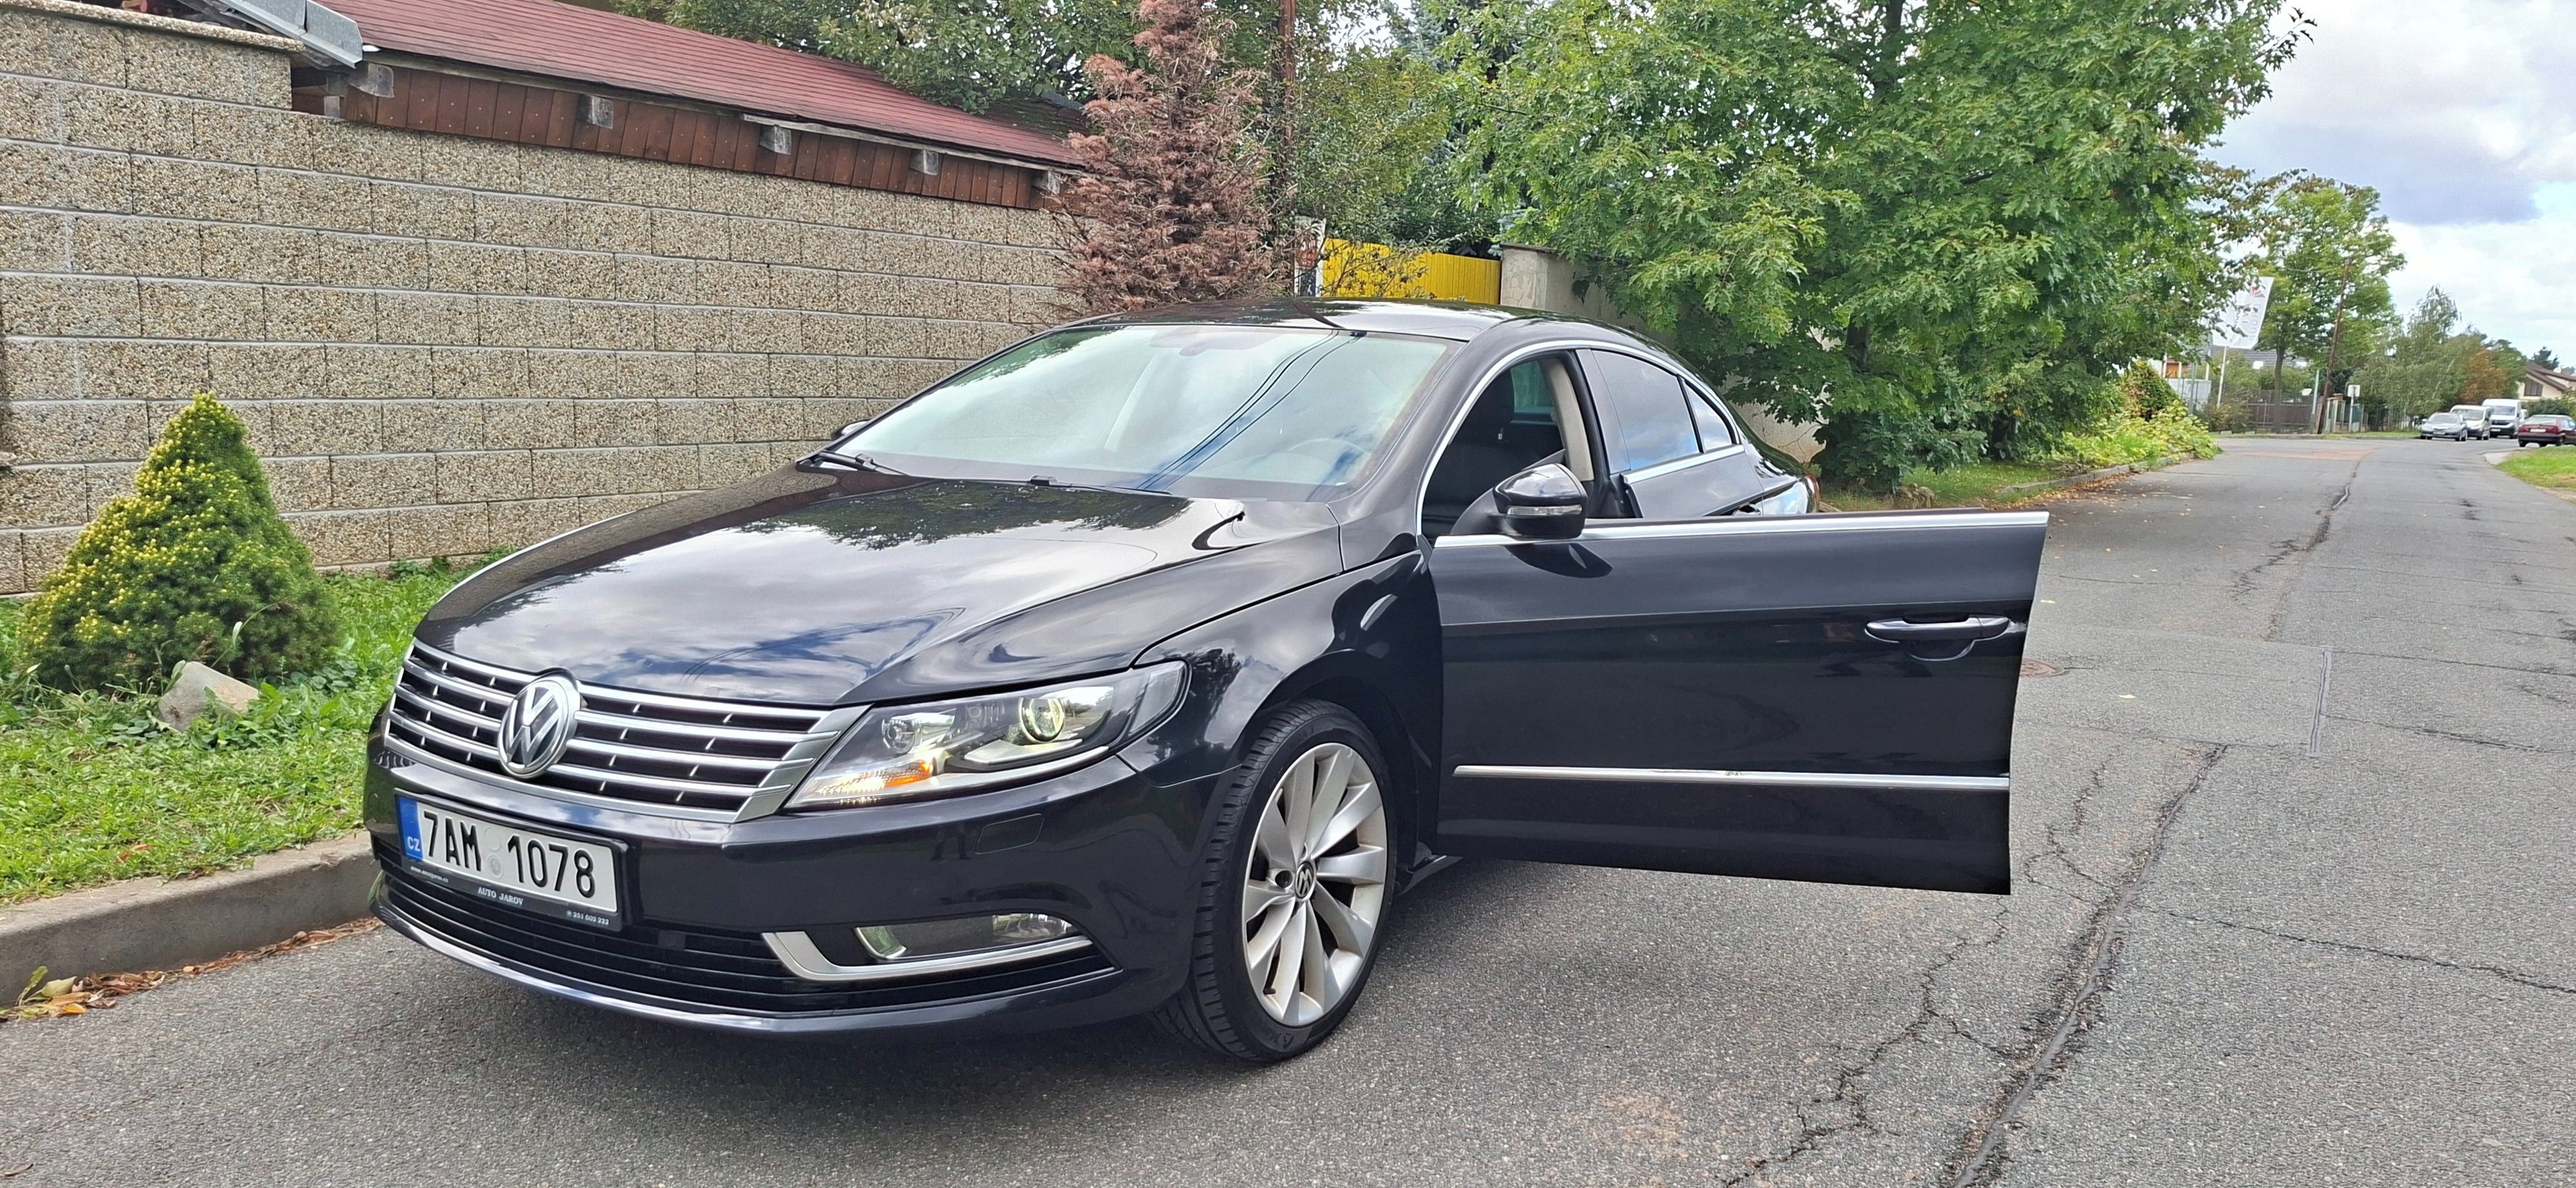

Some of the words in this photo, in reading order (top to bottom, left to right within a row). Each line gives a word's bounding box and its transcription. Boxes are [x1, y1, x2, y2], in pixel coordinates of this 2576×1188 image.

[502, 683, 564, 772] VW
[407, 837, 421, 852] CZ
[423, 810, 482, 872] 7AM
[507, 834, 595, 899] 1078
[478, 886, 497, 898] AUTO
[499, 893, 524, 905] JAROV
